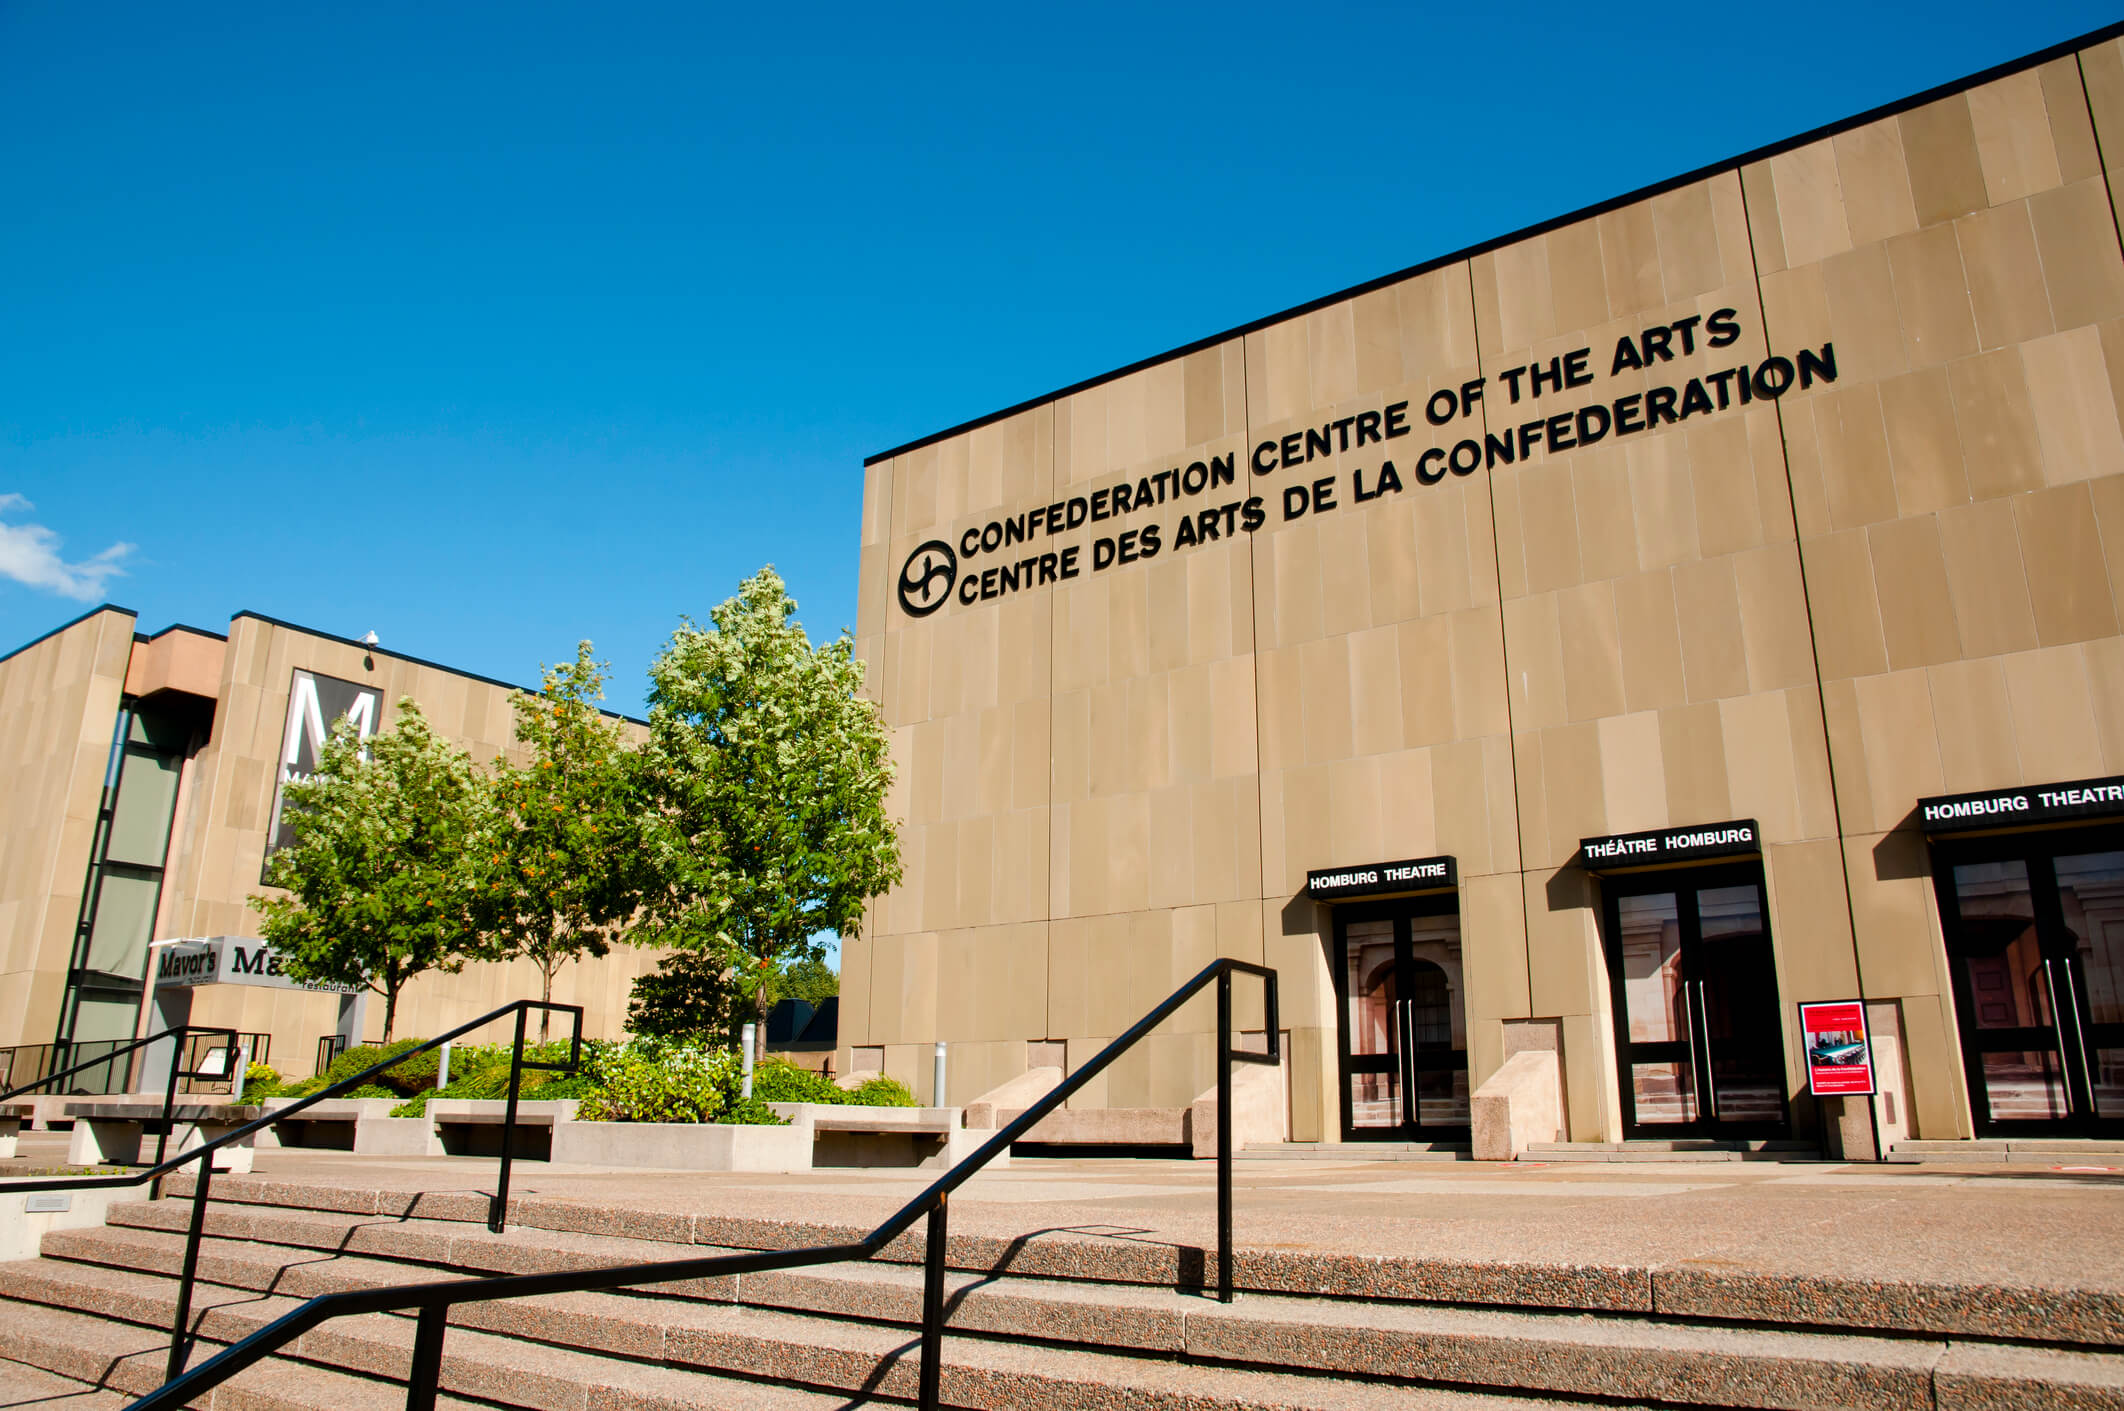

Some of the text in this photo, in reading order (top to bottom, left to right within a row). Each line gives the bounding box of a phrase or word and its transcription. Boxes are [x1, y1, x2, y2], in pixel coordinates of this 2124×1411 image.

[959, 309, 1741, 559] CONFEDERATION CENTRE OF THE ARTS
[958, 342, 1838, 606] CENTRE DES ARTS DE LA CONFEDERATION
[286, 677, 375, 764] M
[1924, 784, 2124, 821] HOMBURG THEATR
[1585, 828, 1752, 858] THÉÂTRE HOMBURG
[1310, 863, 1447, 890] HOMBURG THEATRE
[158, 943, 217, 978] Mavor's
